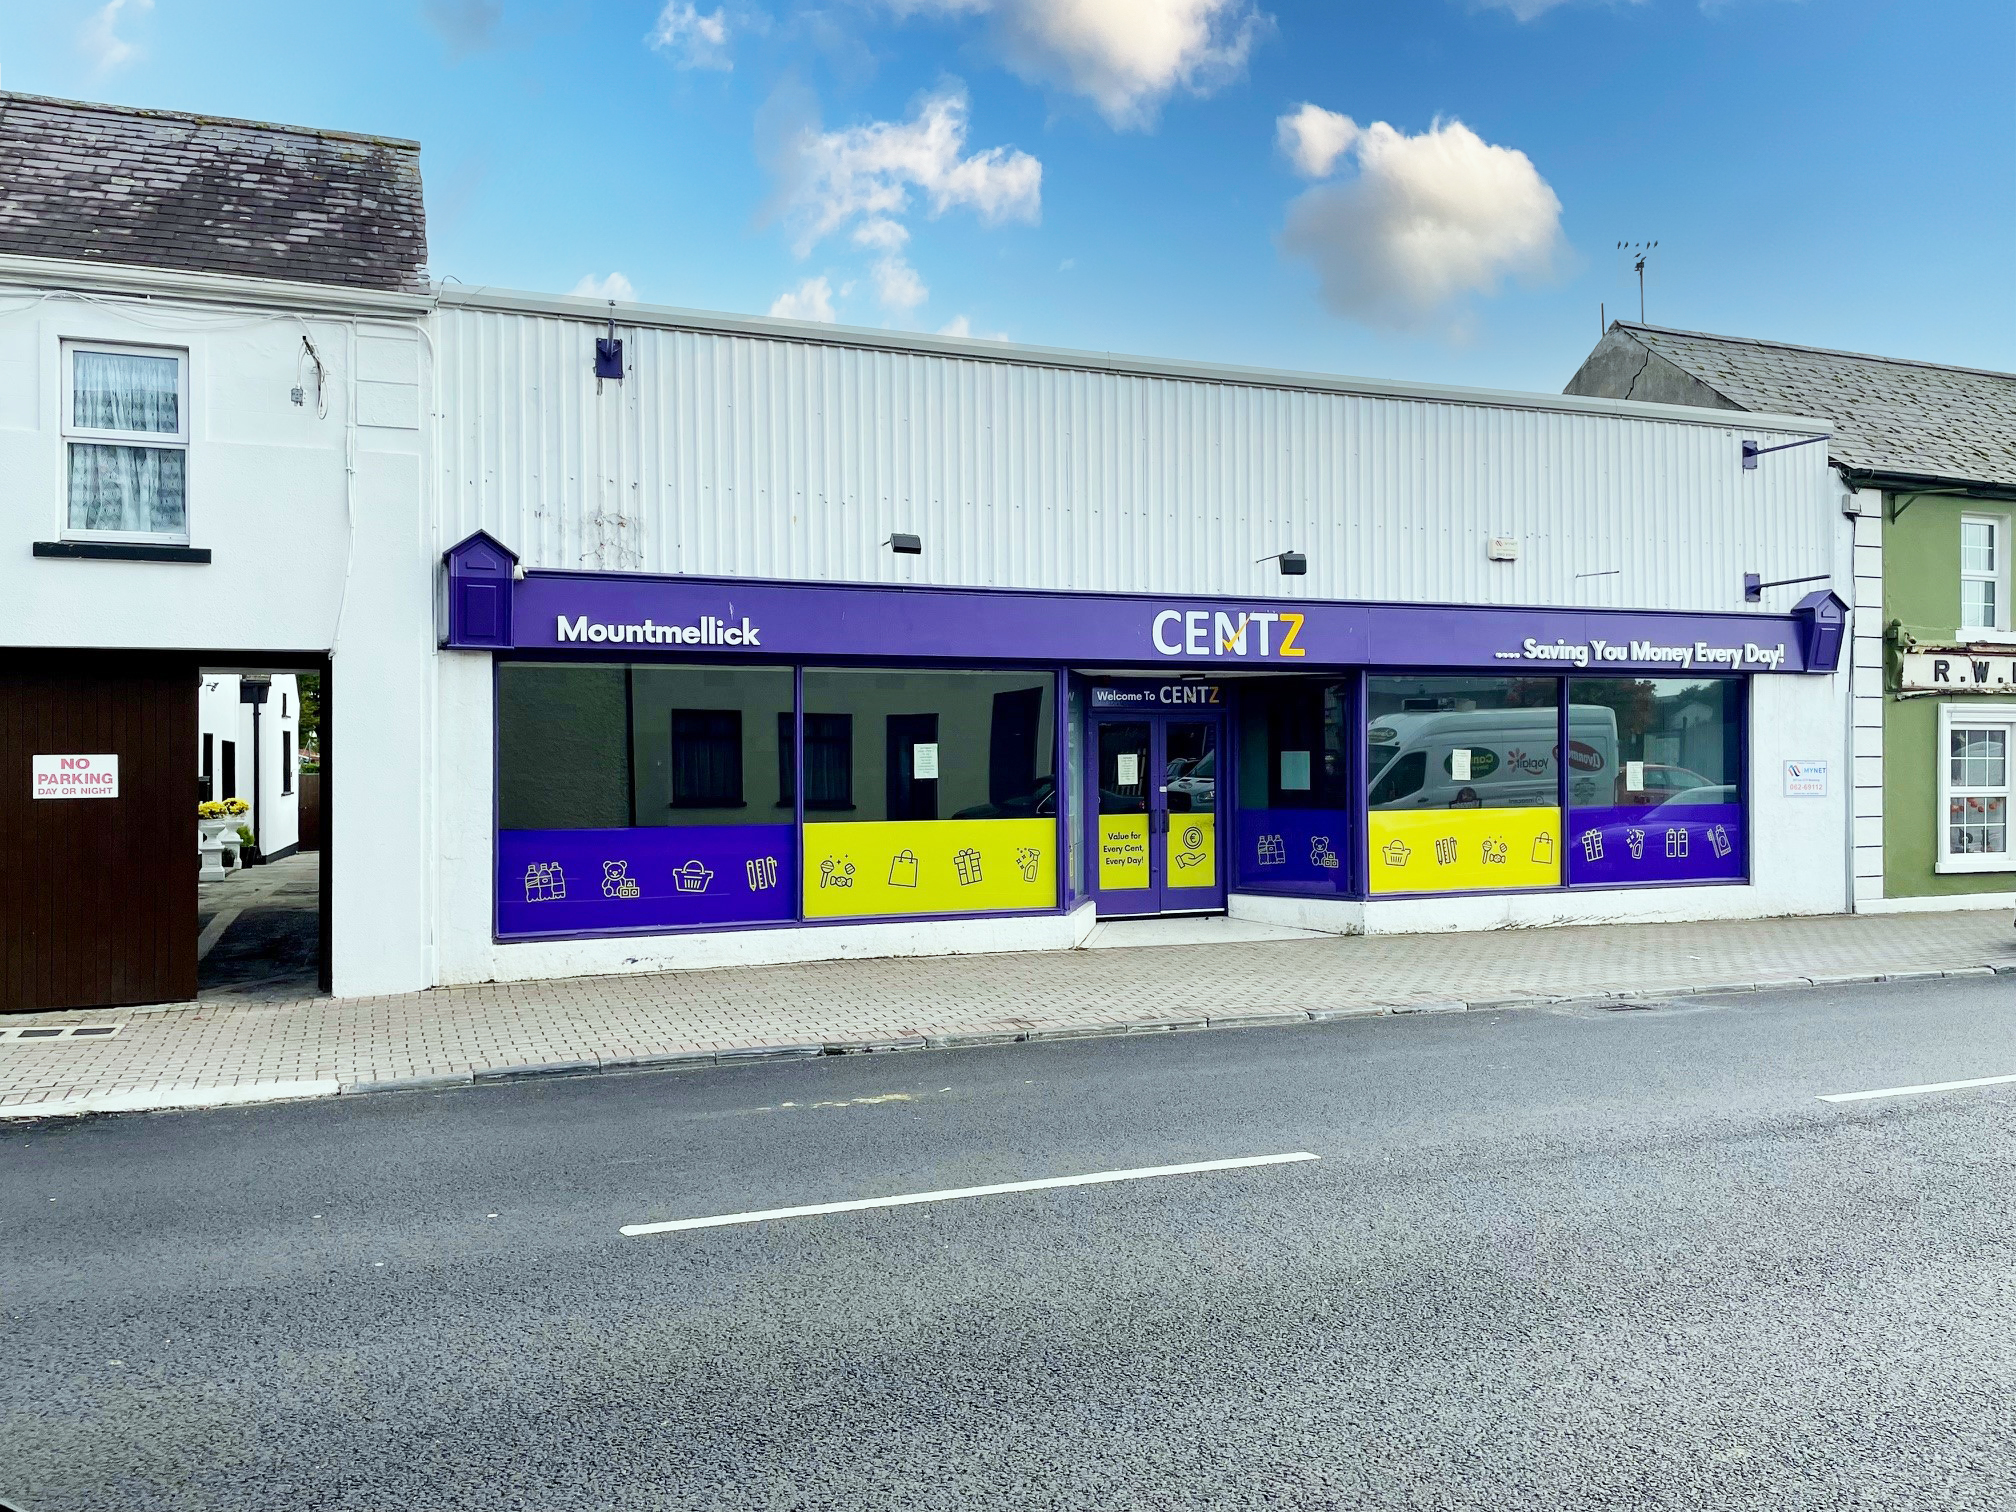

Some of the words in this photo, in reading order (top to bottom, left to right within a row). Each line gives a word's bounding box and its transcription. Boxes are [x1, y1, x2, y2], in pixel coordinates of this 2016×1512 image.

[556, 615, 761, 646] Mountmellick
[1152, 609, 1306, 657] CENTZ
[1589, 640, 1628, 661] You
[1630, 641, 1694, 669] Money
[1694, 641, 1743, 670] Every
[1744, 643, 1785, 671] Day!
[1096, 689, 1143, 701] Welcome
[1143, 690, 1156, 701] To
[1159, 685, 1220, 704] CENTZ
[60, 758, 90, 769] NO
[38, 773, 113, 785] PARKING
[80, 787, 113, 795] NIGHT
[1789, 783, 1823, 791] 062-69112
[1108, 832, 1130, 840] Value
[1130, 831, 1141, 840] for
[1103, 845, 1123, 855] Every
[1124, 844, 1144, 852] Cent,
[1105, 857, 1126, 867] Every
[1126, 856, 1144, 866] Day!
